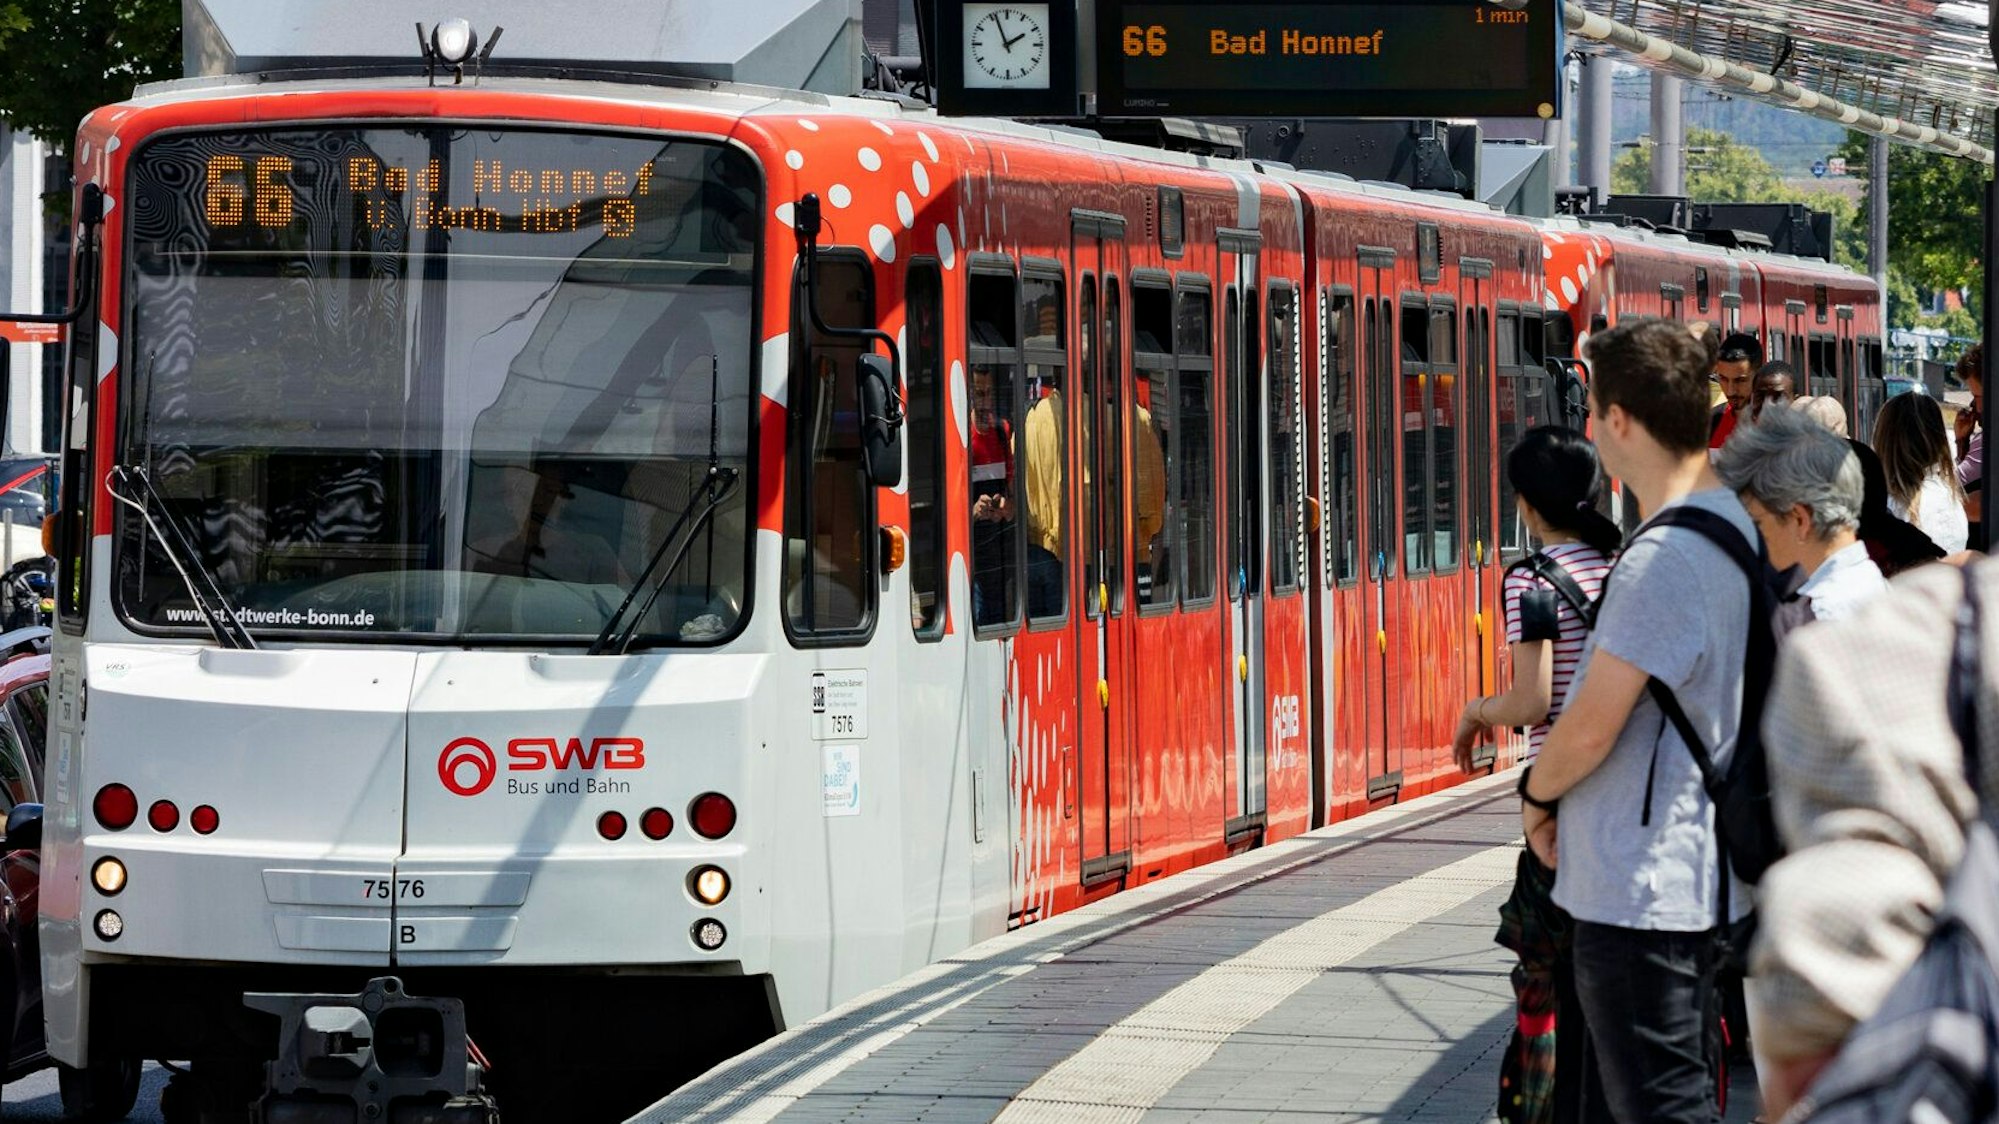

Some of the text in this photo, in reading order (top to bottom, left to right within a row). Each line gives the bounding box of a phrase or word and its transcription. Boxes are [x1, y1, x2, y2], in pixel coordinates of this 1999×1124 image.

[1475, 7, 1529, 24] 1 min
[1122, 25, 1385, 57] 66 Bad Honnef
[206, 155, 654, 227] 66 Bad Honnef
[415, 196, 501, 231] Bonn
[522, 197, 581, 232] Hbf
[166, 606, 375, 626] wwwstdtwerke-bonn.de
[831, 715, 853, 733] 7576
[507, 737, 645, 770] SWB
[507, 777, 631, 795] Bus und Bahn
[400, 925, 416, 944] B
